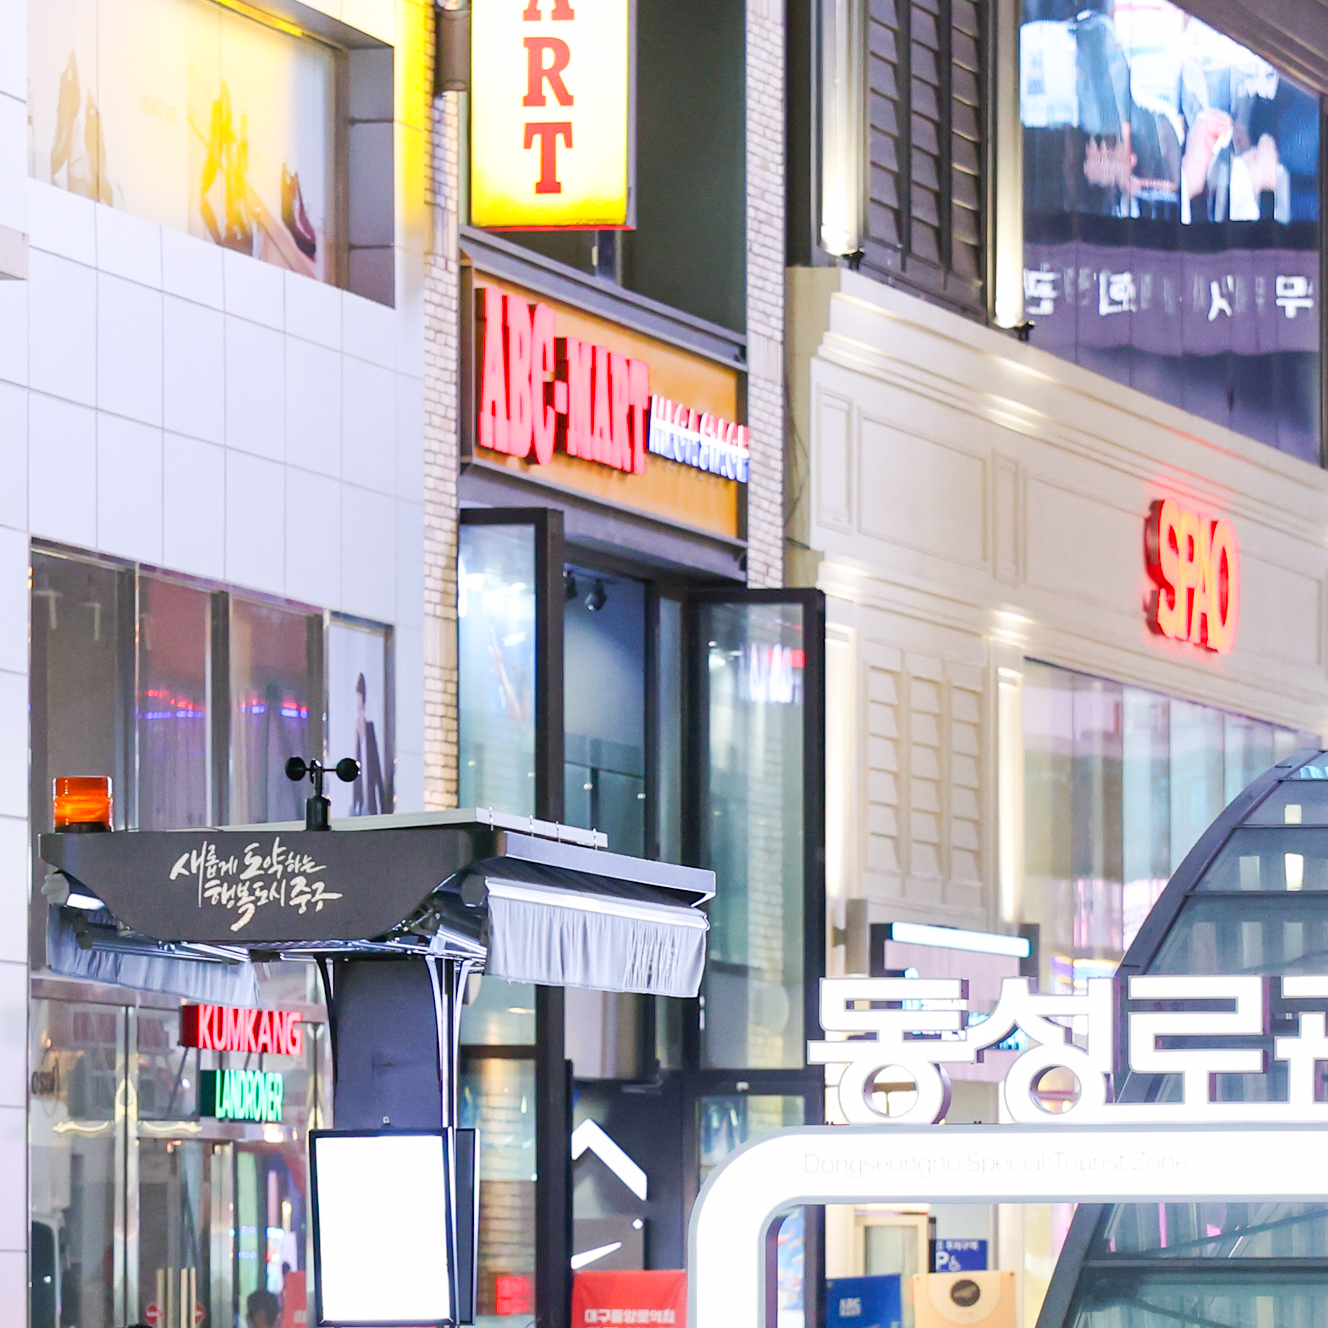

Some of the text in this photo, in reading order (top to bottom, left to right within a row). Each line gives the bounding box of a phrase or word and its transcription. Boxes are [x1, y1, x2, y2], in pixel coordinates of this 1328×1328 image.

[522, 0, 575, 195] RT
[478, 287, 651, 476] ABC-MART
[1156, 498, 1239, 656] SPAO
[169, 836, 327, 908] 새롭게 도약하는
[203, 875, 344, 932] 행복도시 중구
[198, 1003, 304, 1057] KUMKANG
[215, 1068, 284, 1121] LANDROVER
[803, 1150, 1190, 1178] Dongseongno Special Tourist Zone
